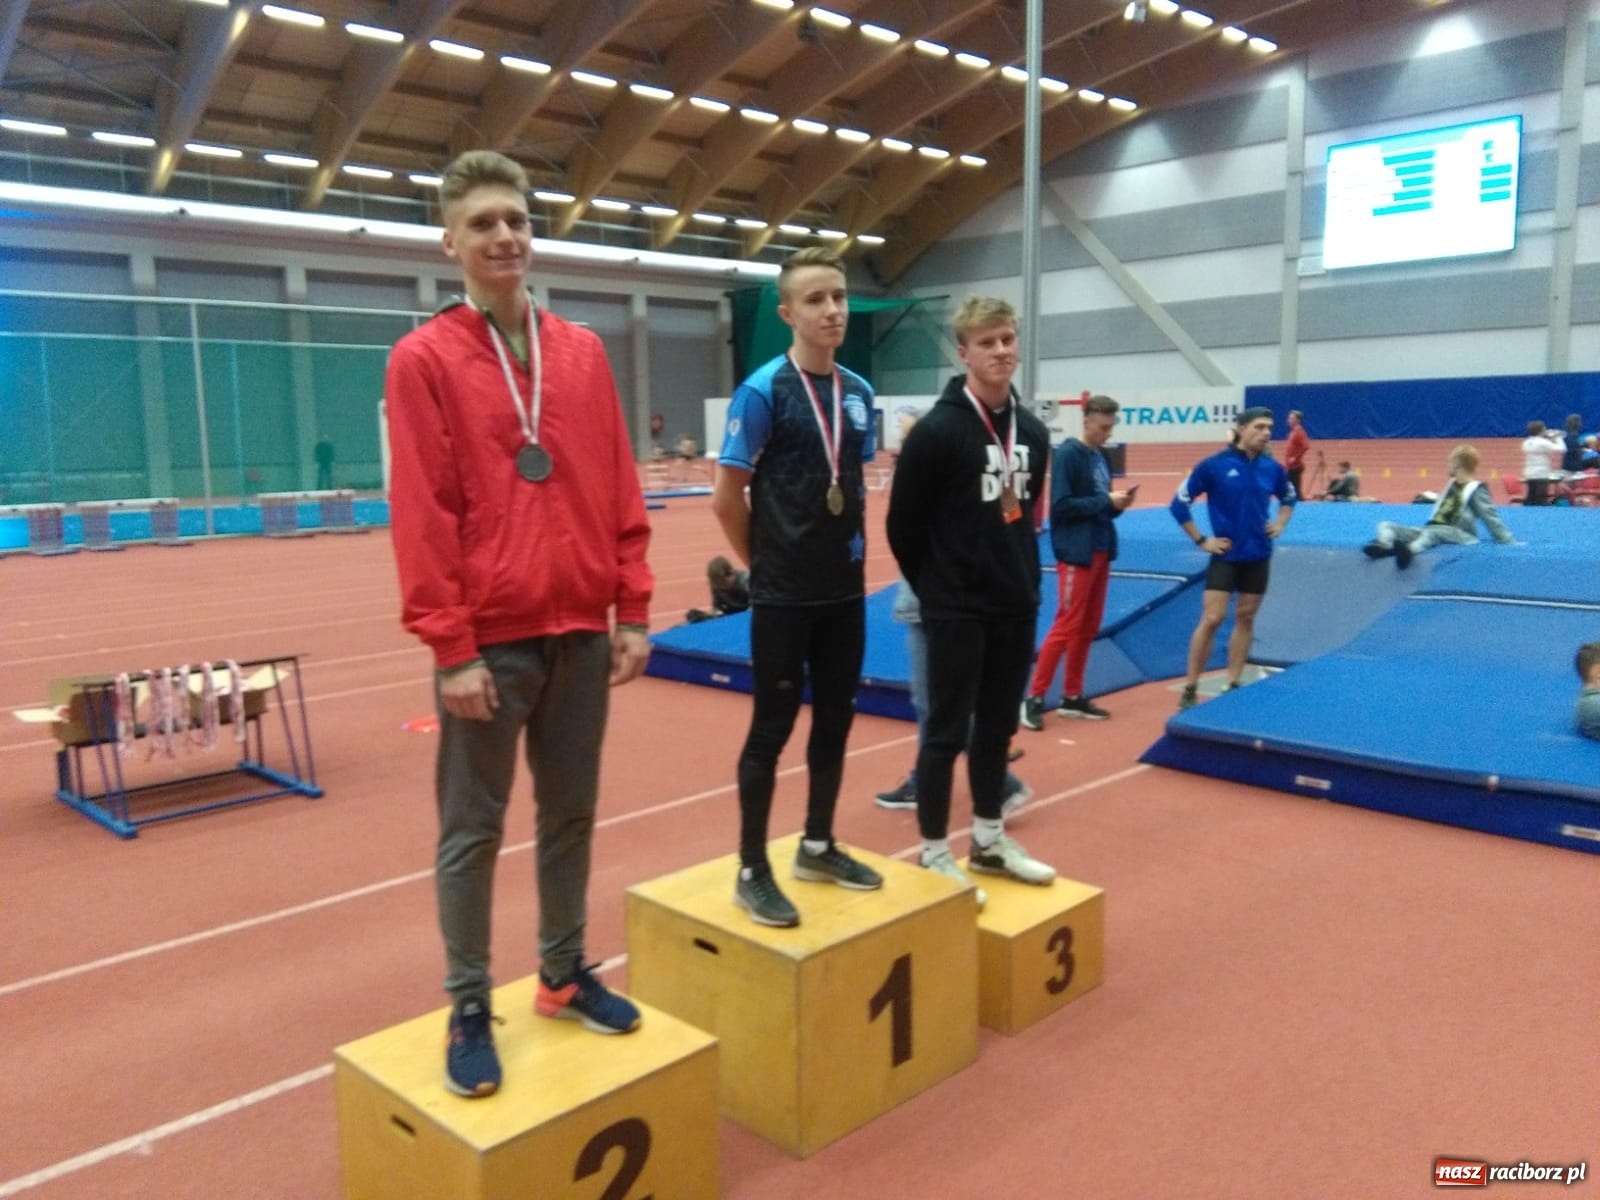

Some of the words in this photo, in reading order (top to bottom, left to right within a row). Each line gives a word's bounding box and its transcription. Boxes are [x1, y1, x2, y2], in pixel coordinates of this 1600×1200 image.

[1114, 405, 1237, 425] TRAVA!!!
[985, 444, 1029, 473] JST
[1046, 926, 1075, 995] 3
[869, 953, 912, 1068] 1
[573, 1117, 653, 1200] 2
